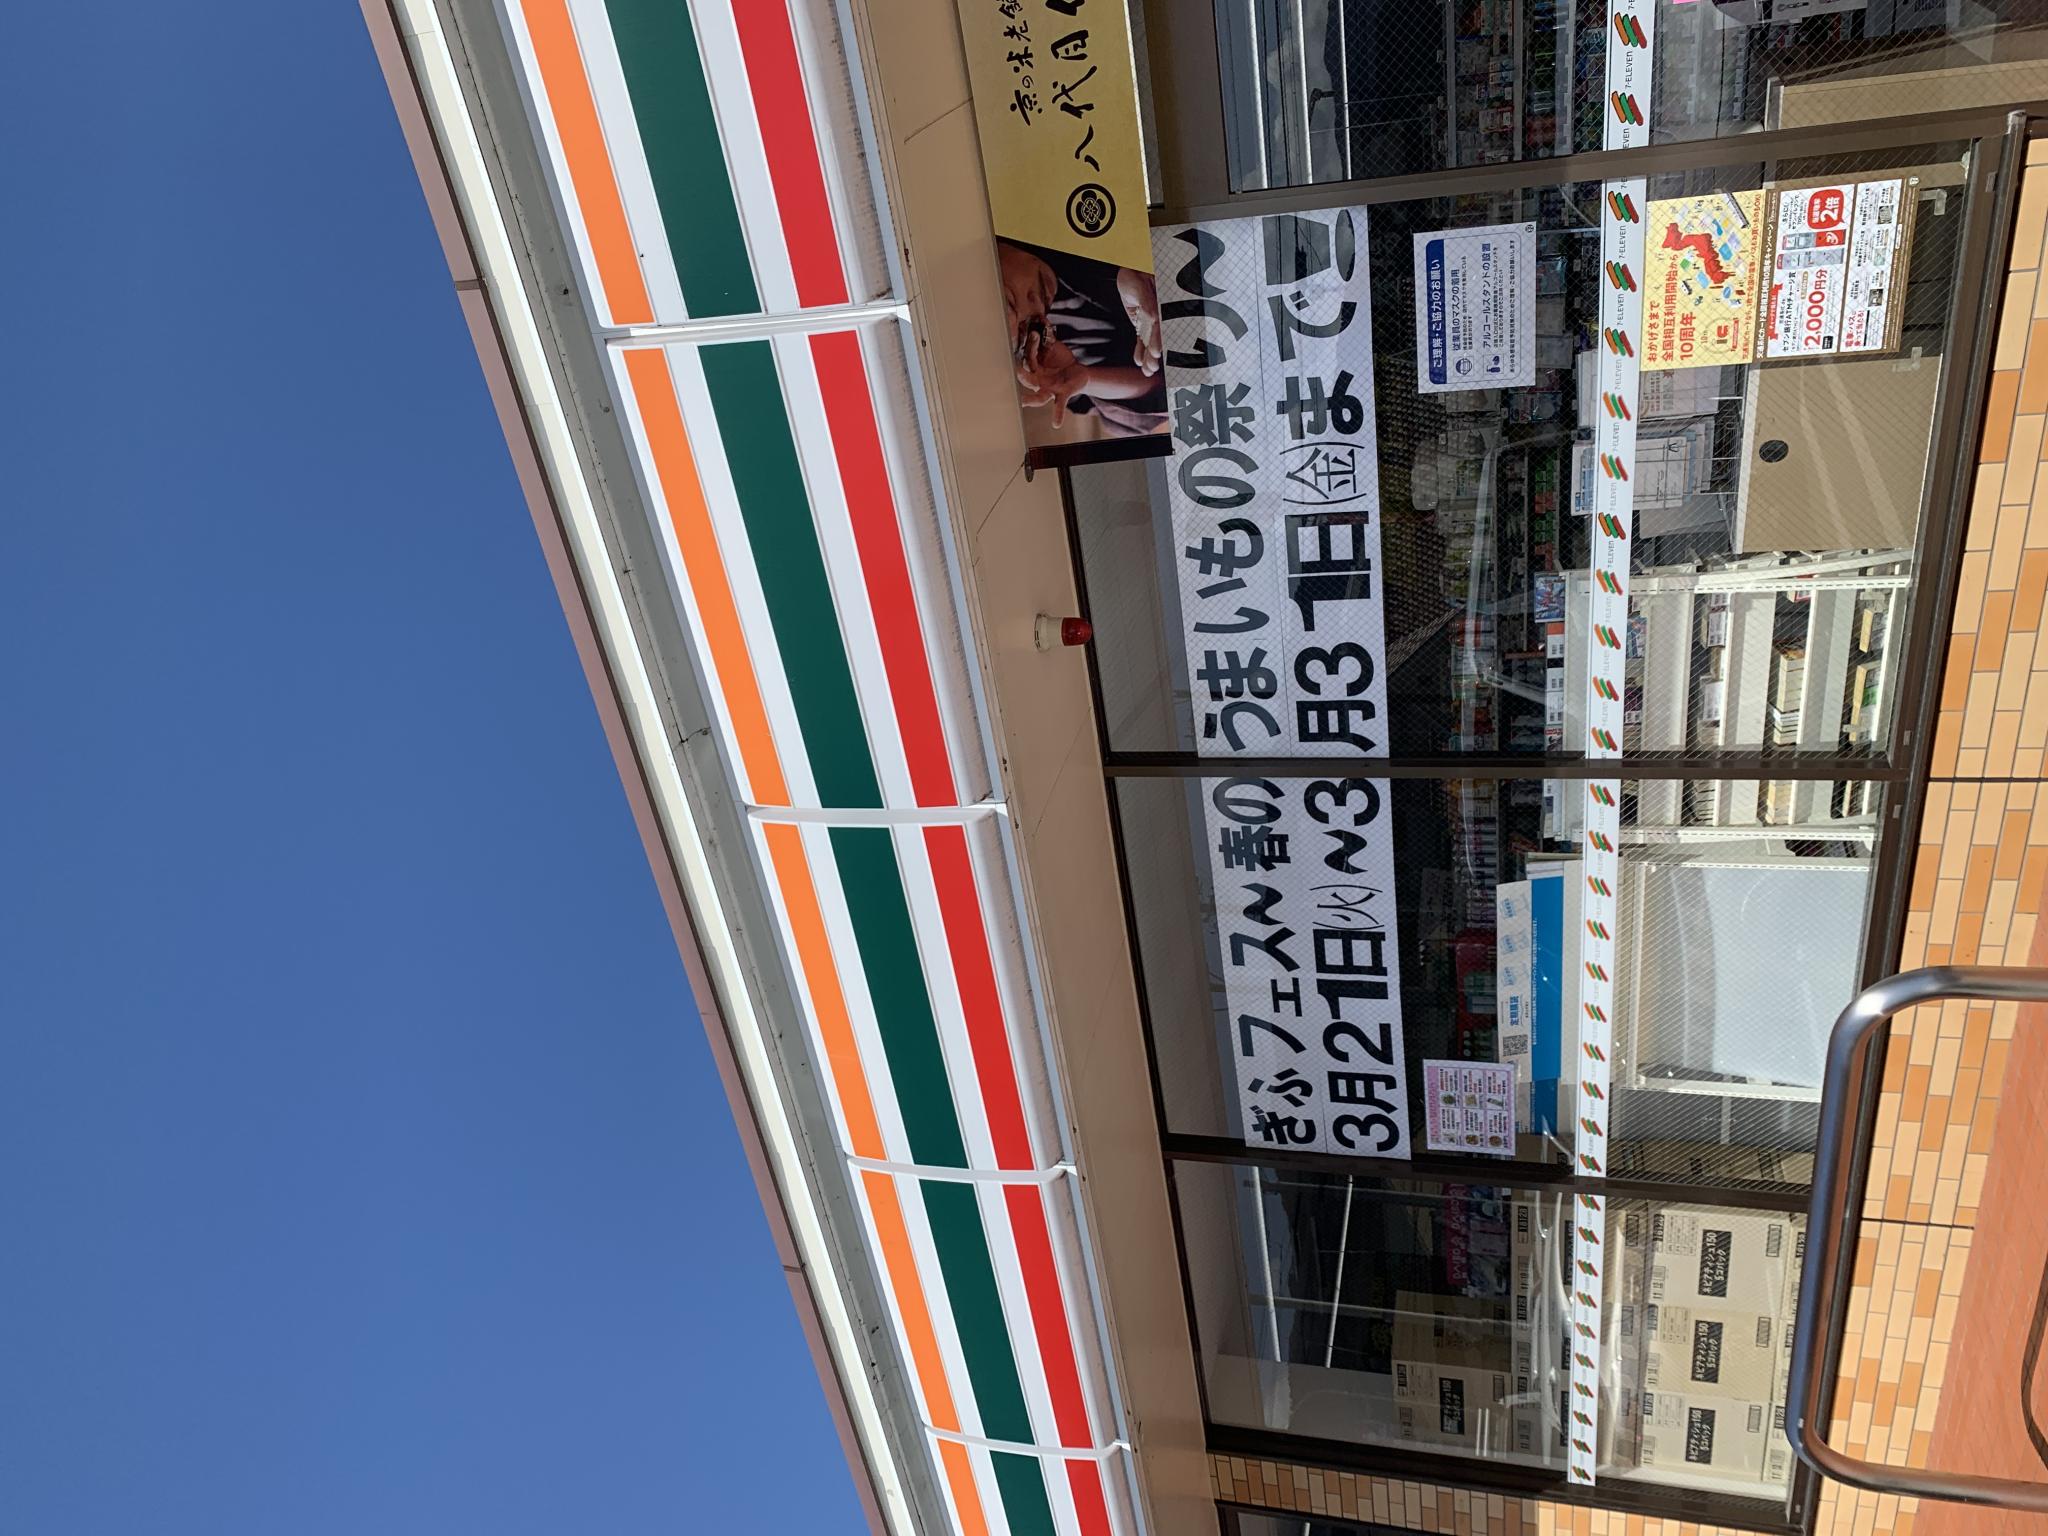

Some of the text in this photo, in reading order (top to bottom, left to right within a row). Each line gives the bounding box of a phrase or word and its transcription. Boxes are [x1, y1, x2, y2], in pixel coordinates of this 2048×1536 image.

[1820, 196, 1840, 223] 2倍
[1431, 259, 1443, 368] ご理解・ご協力のお願い
[1451, 269, 1461, 351] 従業員のマスクの着用
[1481, 242, 1491, 349] アルコールスタンドの設置
[1647, 300, 1660, 362] おかげさまで
[1661, 254, 1678, 362] 全国相互利用開始から
[1803, 269, 1828, 347] 2,000円分
[1679, 311, 1697, 361] 10周年
[1702, 1232, 1717, 1293] ネピアティシュ150
